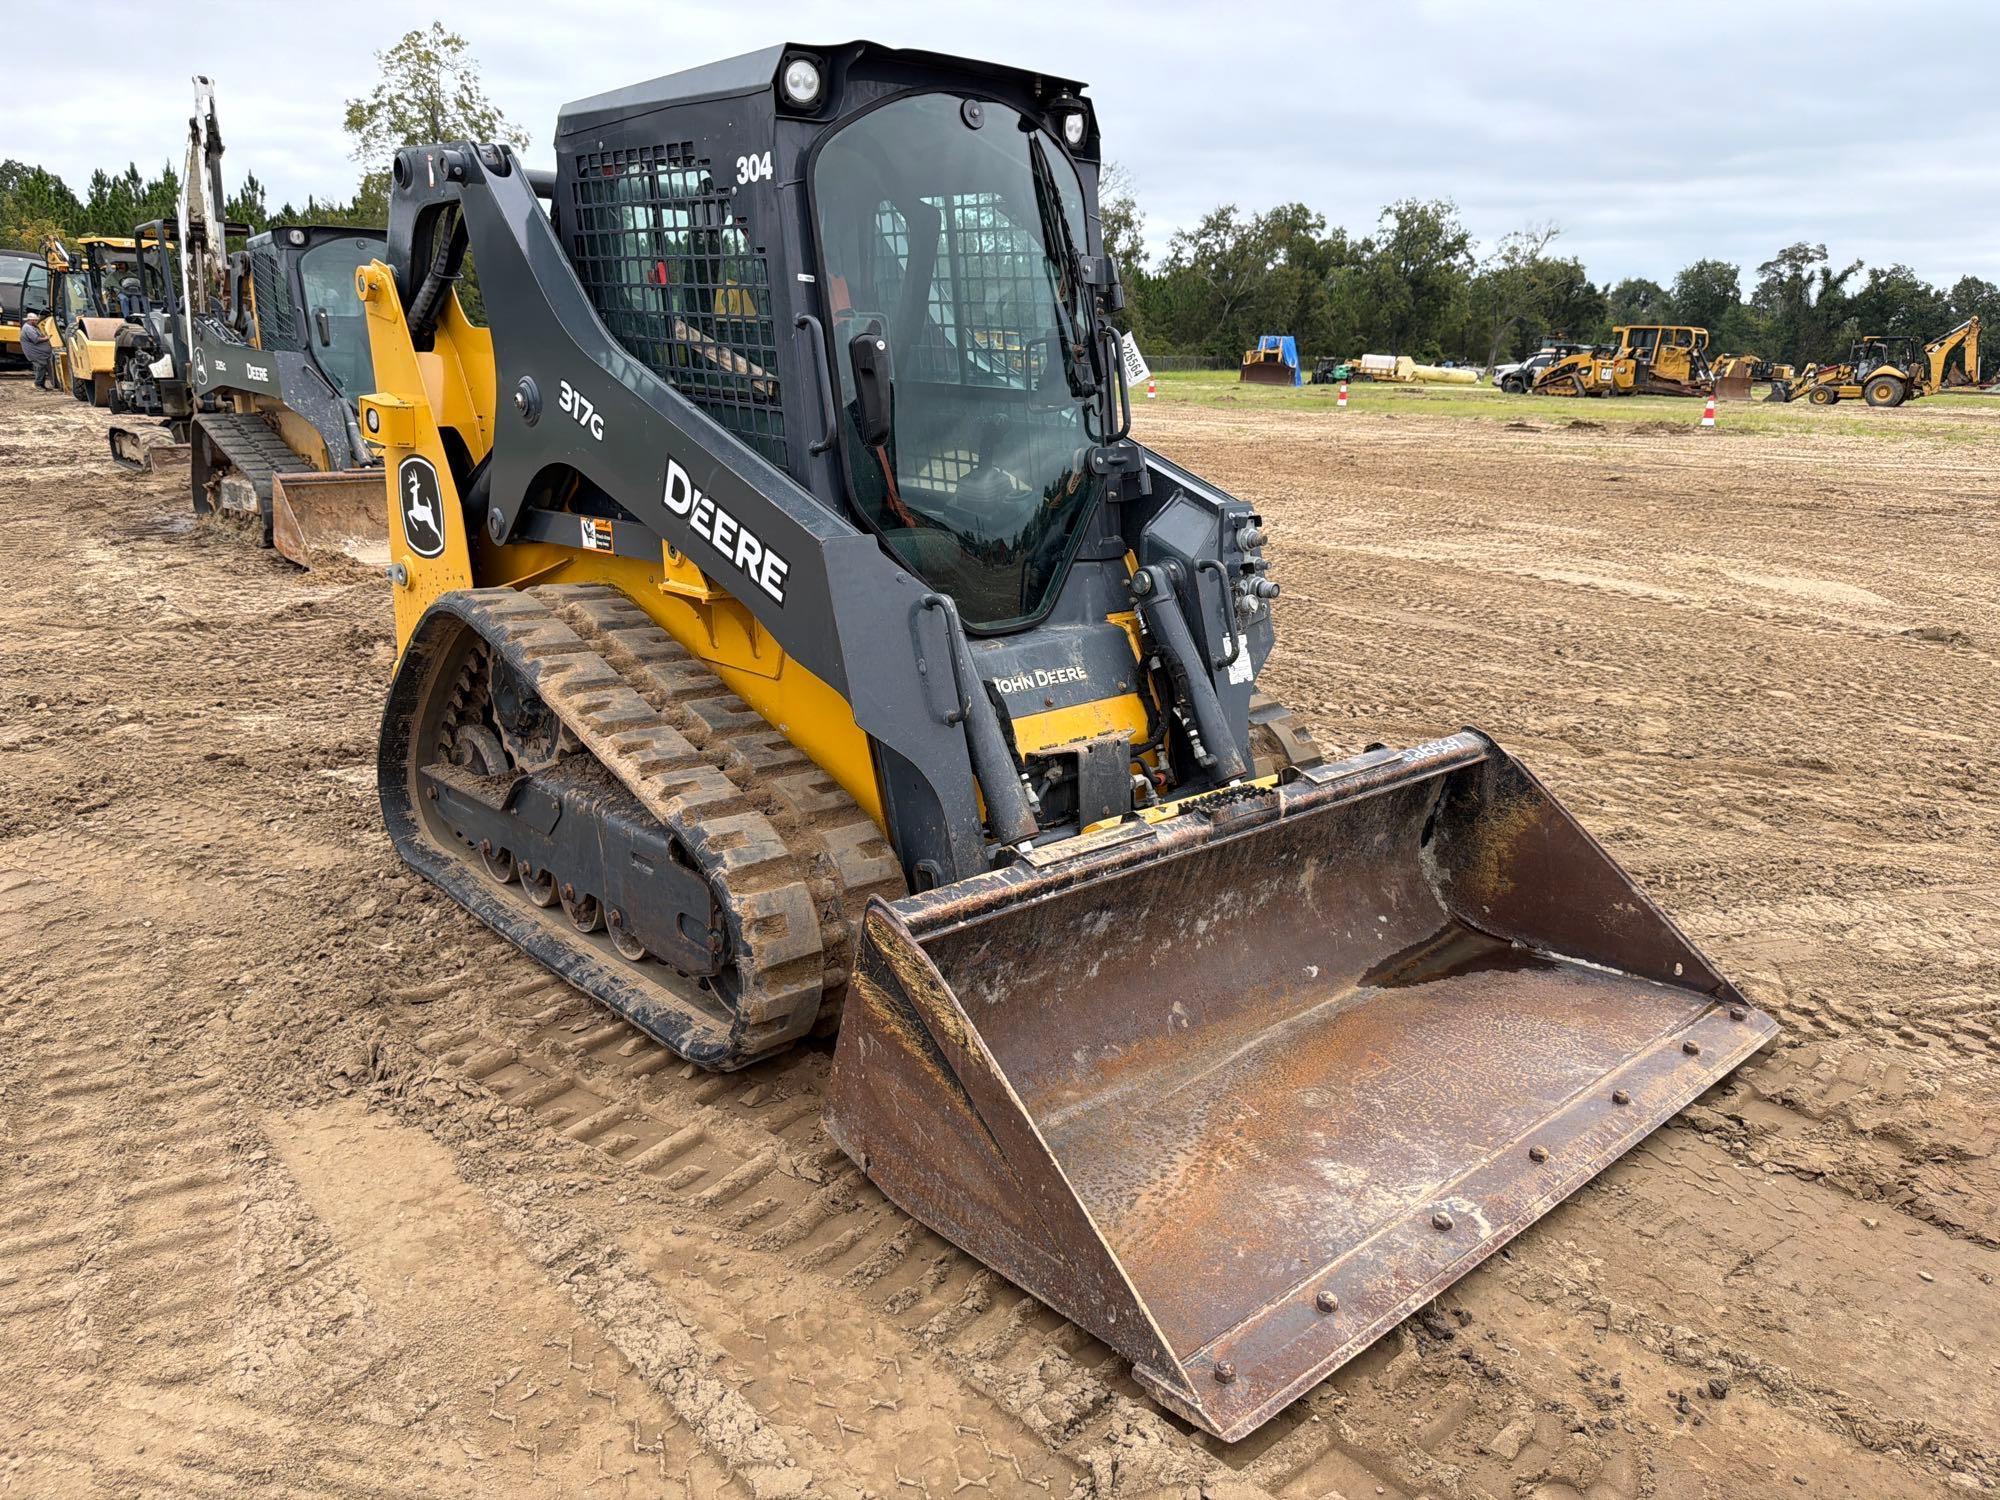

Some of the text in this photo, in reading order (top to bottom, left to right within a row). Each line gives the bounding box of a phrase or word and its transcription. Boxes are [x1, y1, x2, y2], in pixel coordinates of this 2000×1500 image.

[736, 151, 773, 184] 304
[246, 363, 269, 382] DEERE
[1122, 343, 1144, 377] 226564
[558, 380, 605, 441] 317G
[663, 458, 789, 603] DEERE
[1034, 666, 1087, 687] DEERE
